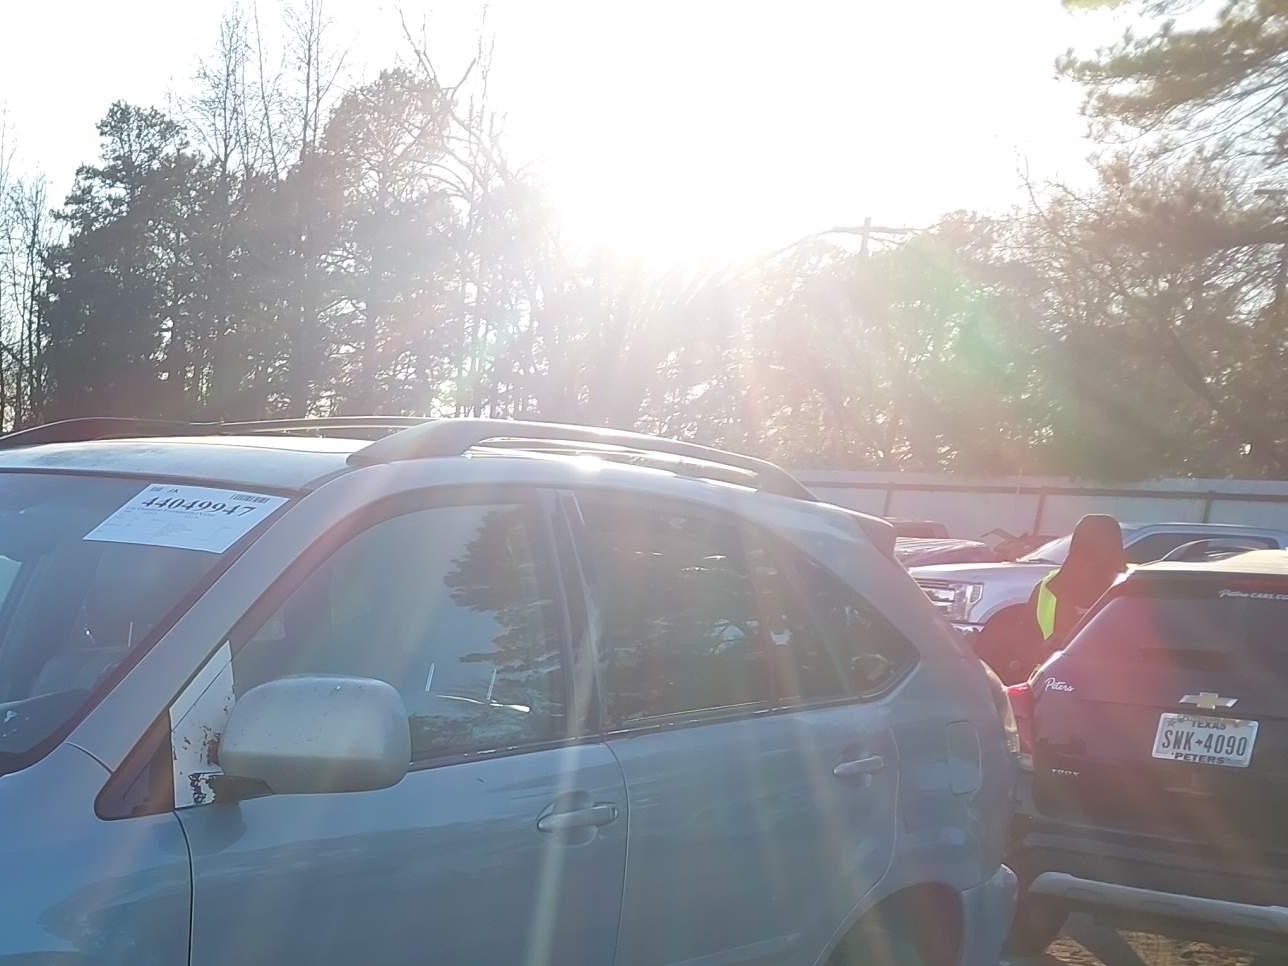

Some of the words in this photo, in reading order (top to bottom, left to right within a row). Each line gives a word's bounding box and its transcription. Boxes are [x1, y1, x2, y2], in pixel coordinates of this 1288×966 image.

[141, 496, 257, 517] 44049947
[1045, 677, 1075, 692] Peters
[1192, 720, 1226, 731] TEXAS
[1174, 752, 1225, 765] PETERS
